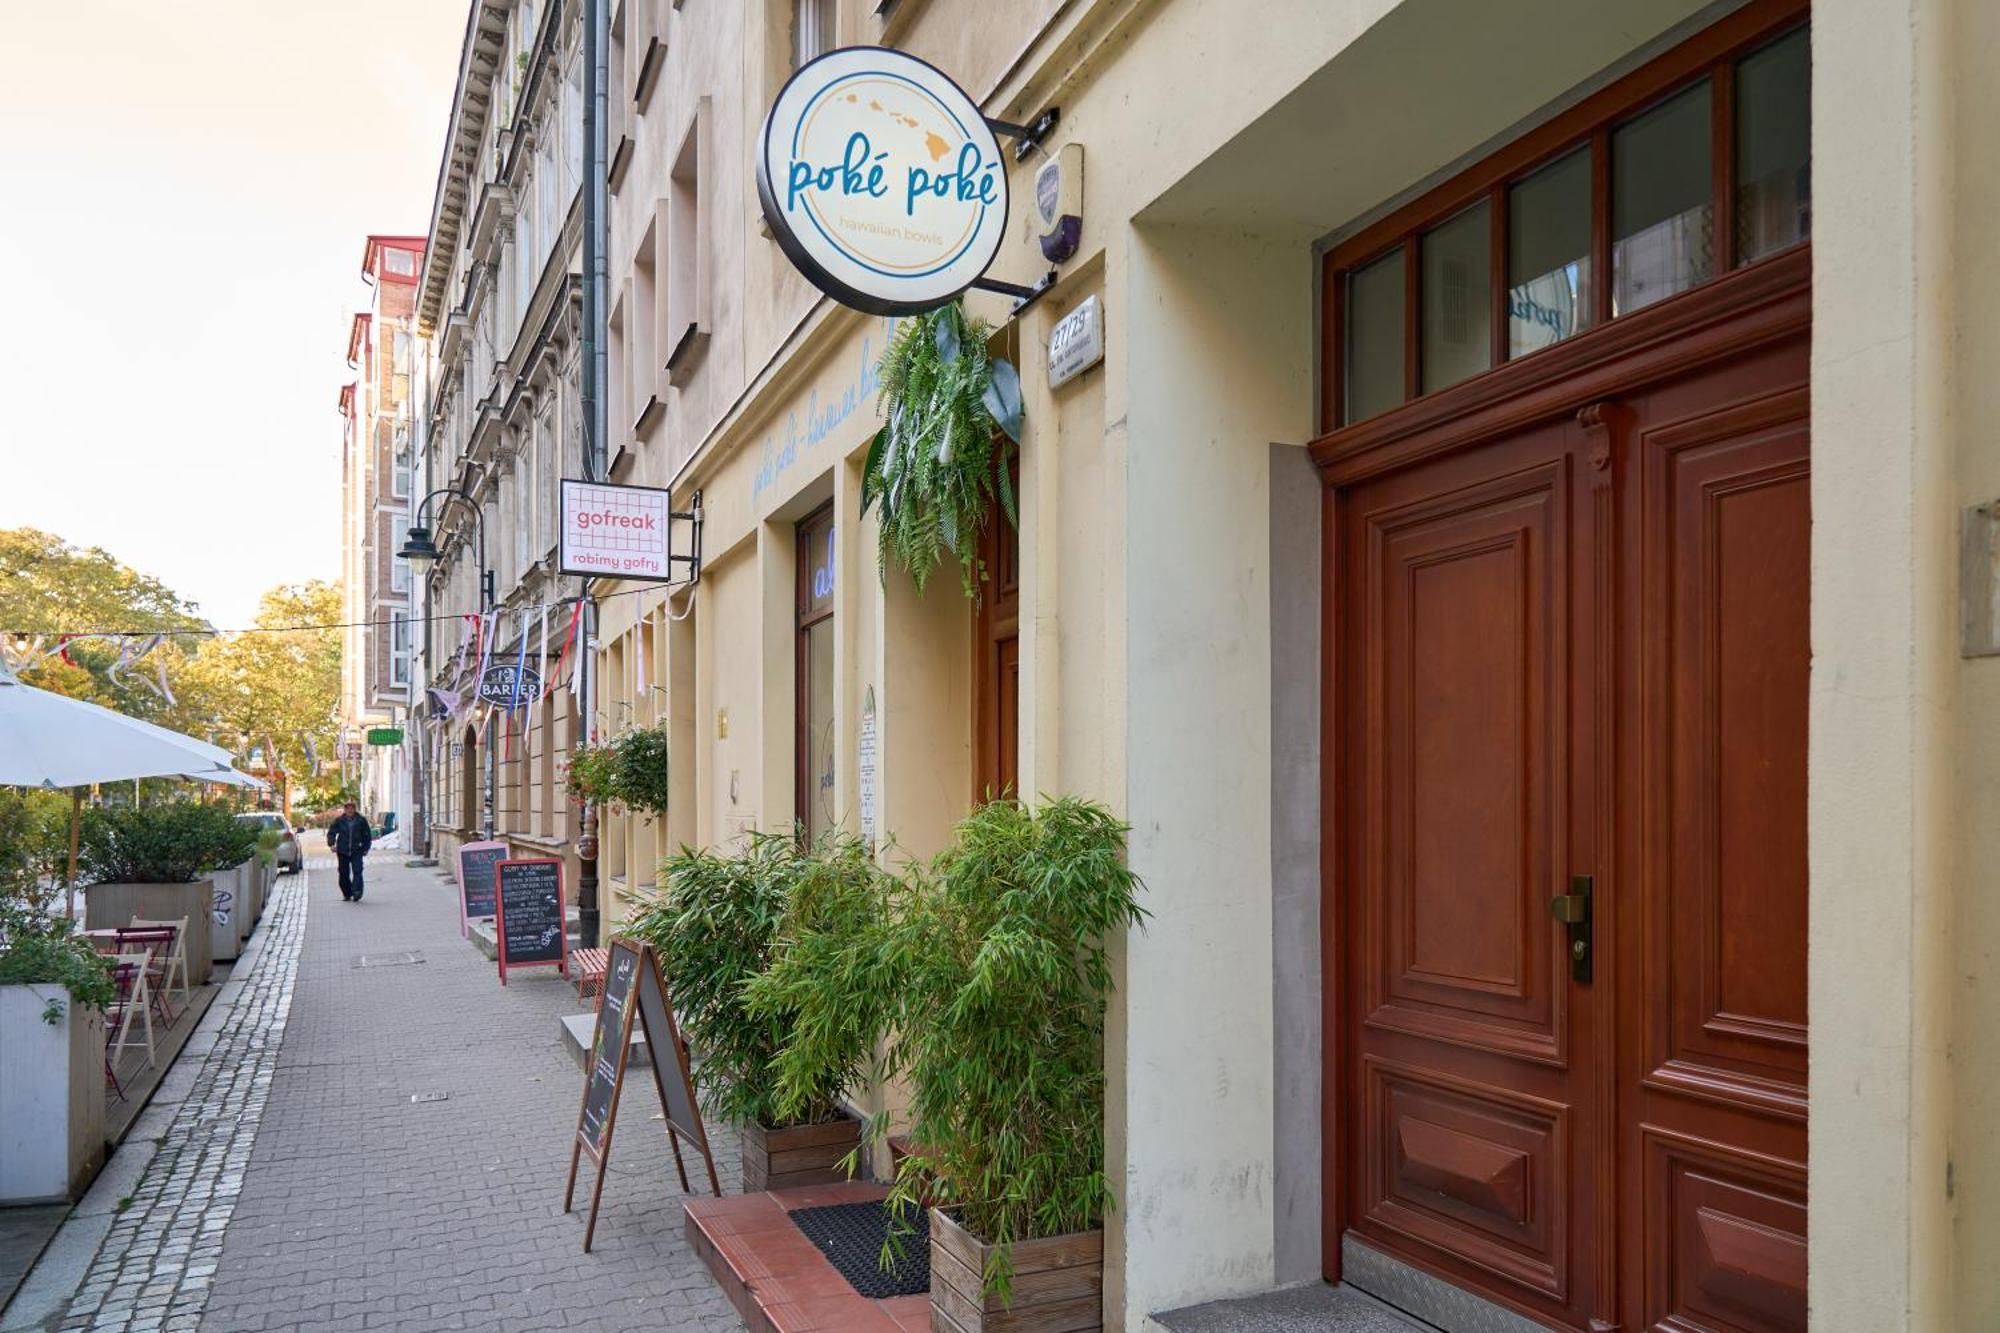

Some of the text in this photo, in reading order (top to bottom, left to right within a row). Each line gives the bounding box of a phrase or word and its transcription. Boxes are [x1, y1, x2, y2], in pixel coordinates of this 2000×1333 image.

[788, 131, 998, 217] poké poké
[839, 215, 945, 246] hawaiian bowls
[1053, 309, 1086, 351] 27/29
[577, 510, 655, 531] gofreak
[572, 552, 660, 573] robimy gofry
